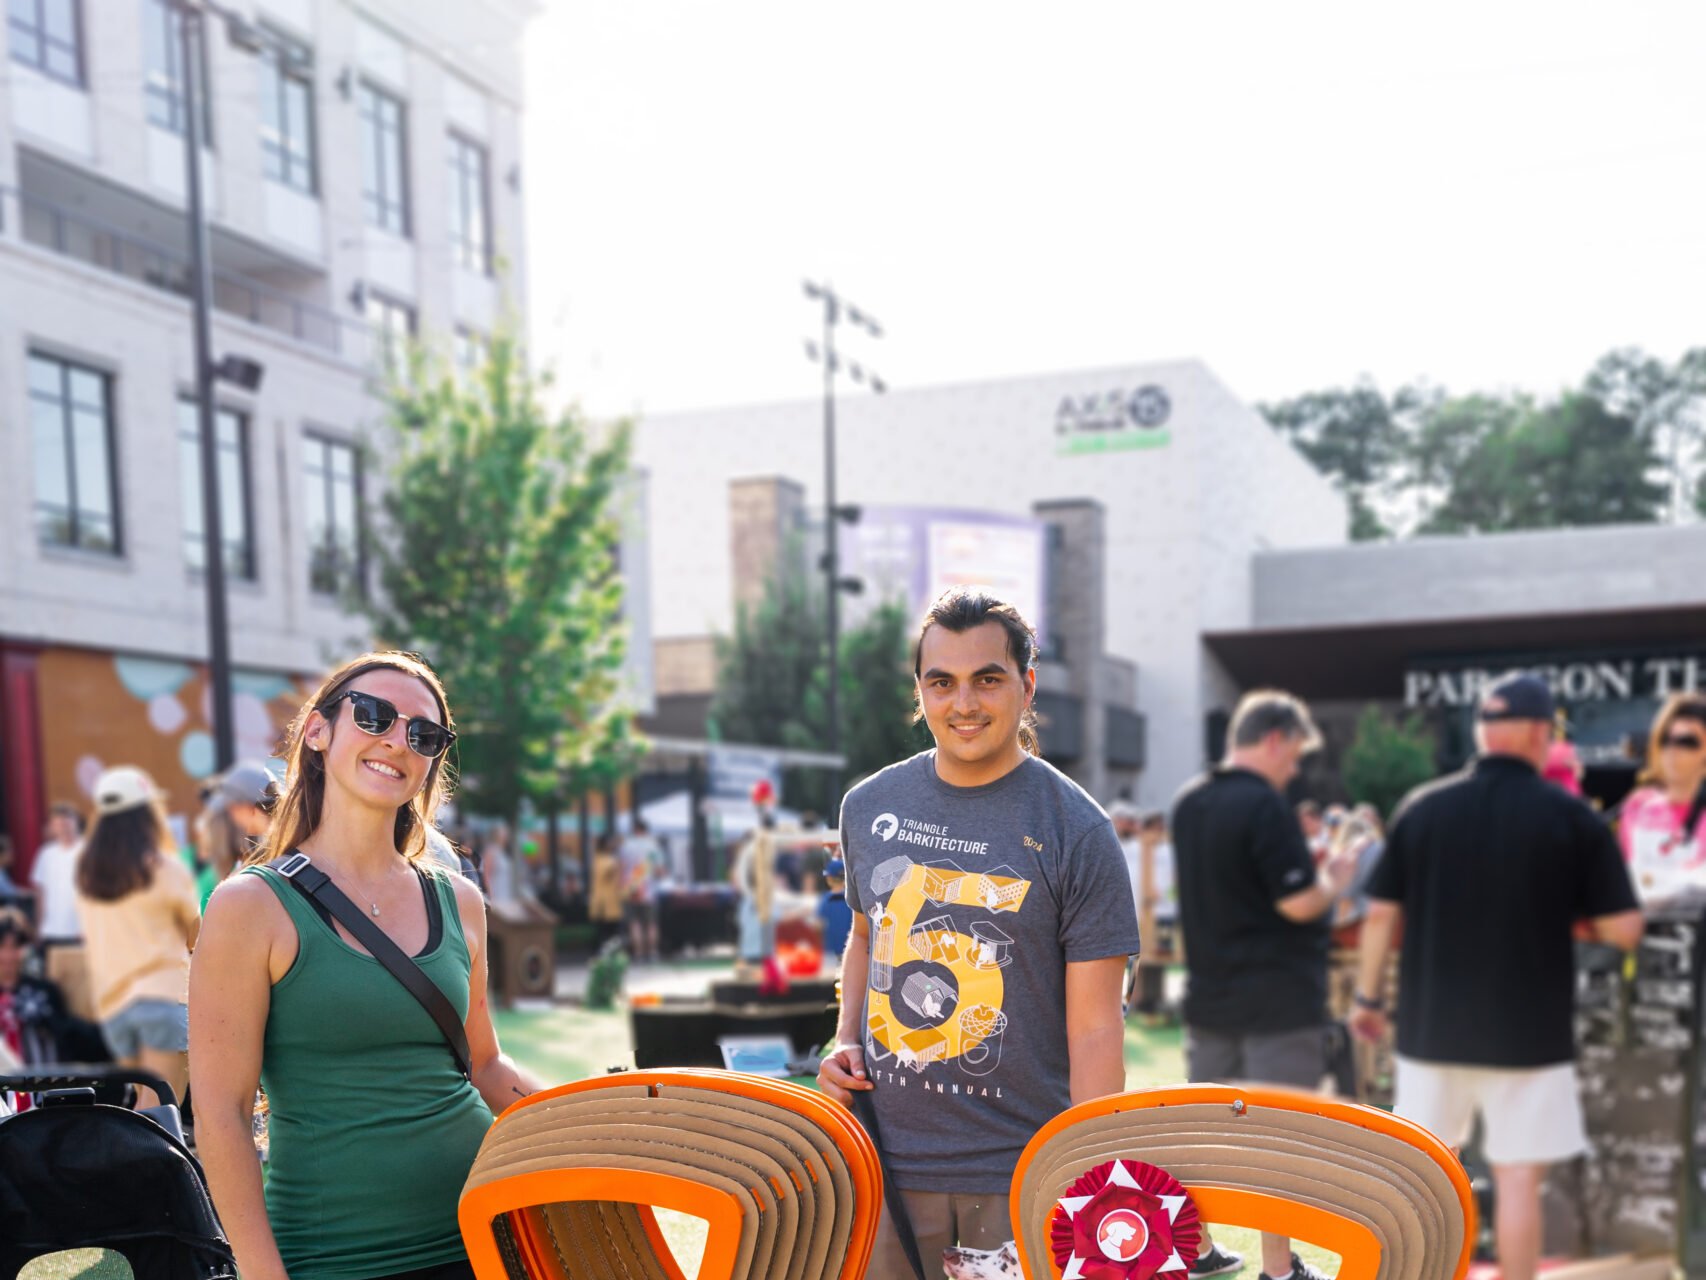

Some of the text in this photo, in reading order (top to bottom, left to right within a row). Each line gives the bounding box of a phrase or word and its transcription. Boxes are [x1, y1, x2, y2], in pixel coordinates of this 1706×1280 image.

[902, 818, 949, 836] TRIANGLE
[897, 829, 990, 855] BARKITECTURE
[1023, 835, 1044, 852] 2024
[924, 1080, 1002, 1098] ANNUAL
